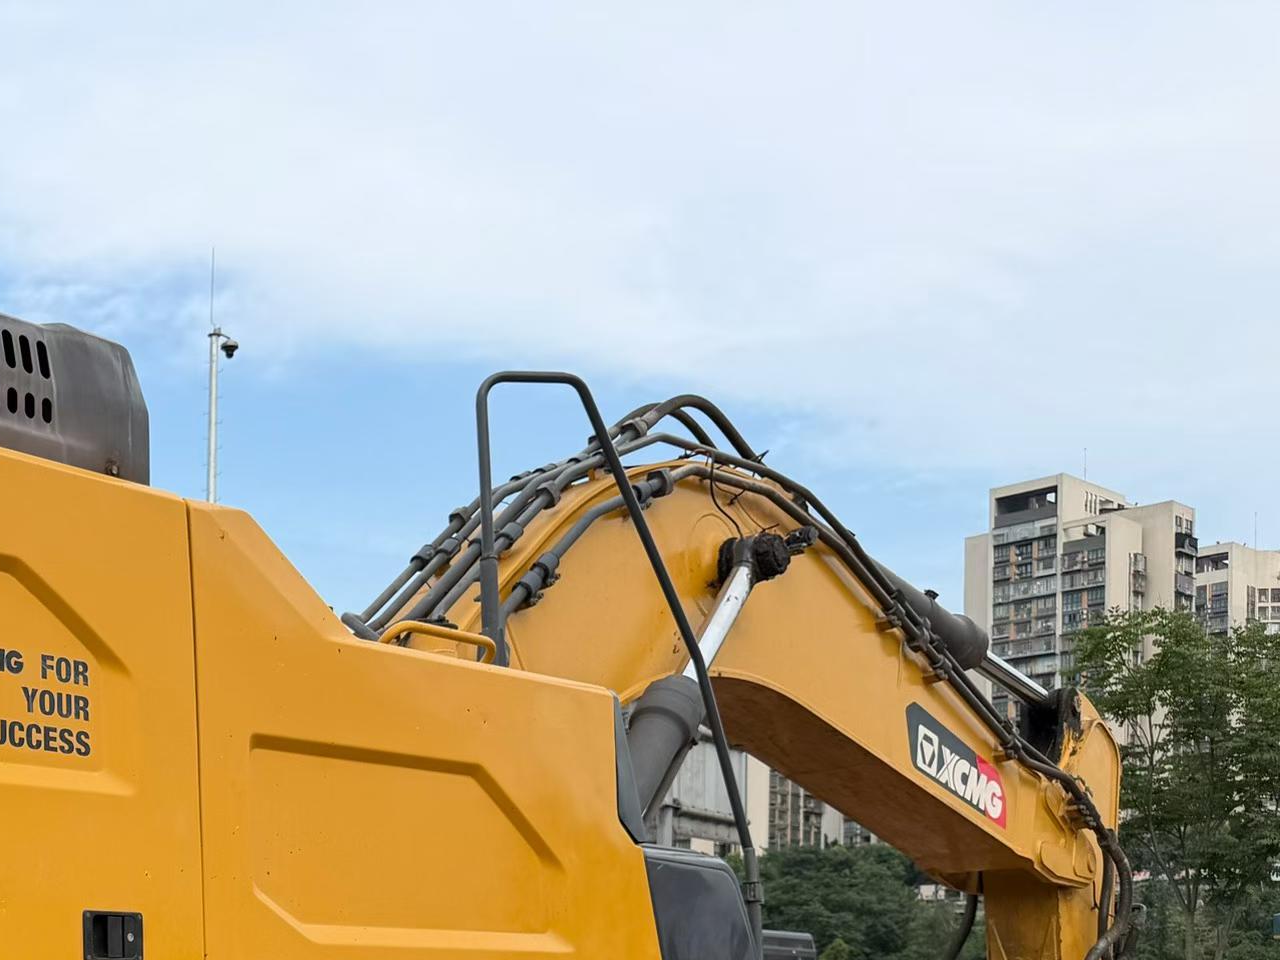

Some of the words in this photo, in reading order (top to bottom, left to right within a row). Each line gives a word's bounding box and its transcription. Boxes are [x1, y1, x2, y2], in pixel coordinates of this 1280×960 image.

[40, 655, 89, 687] FOR
[22, 687, 90, 722] YOUR
[936, 744, 1003, 820] XCMG
